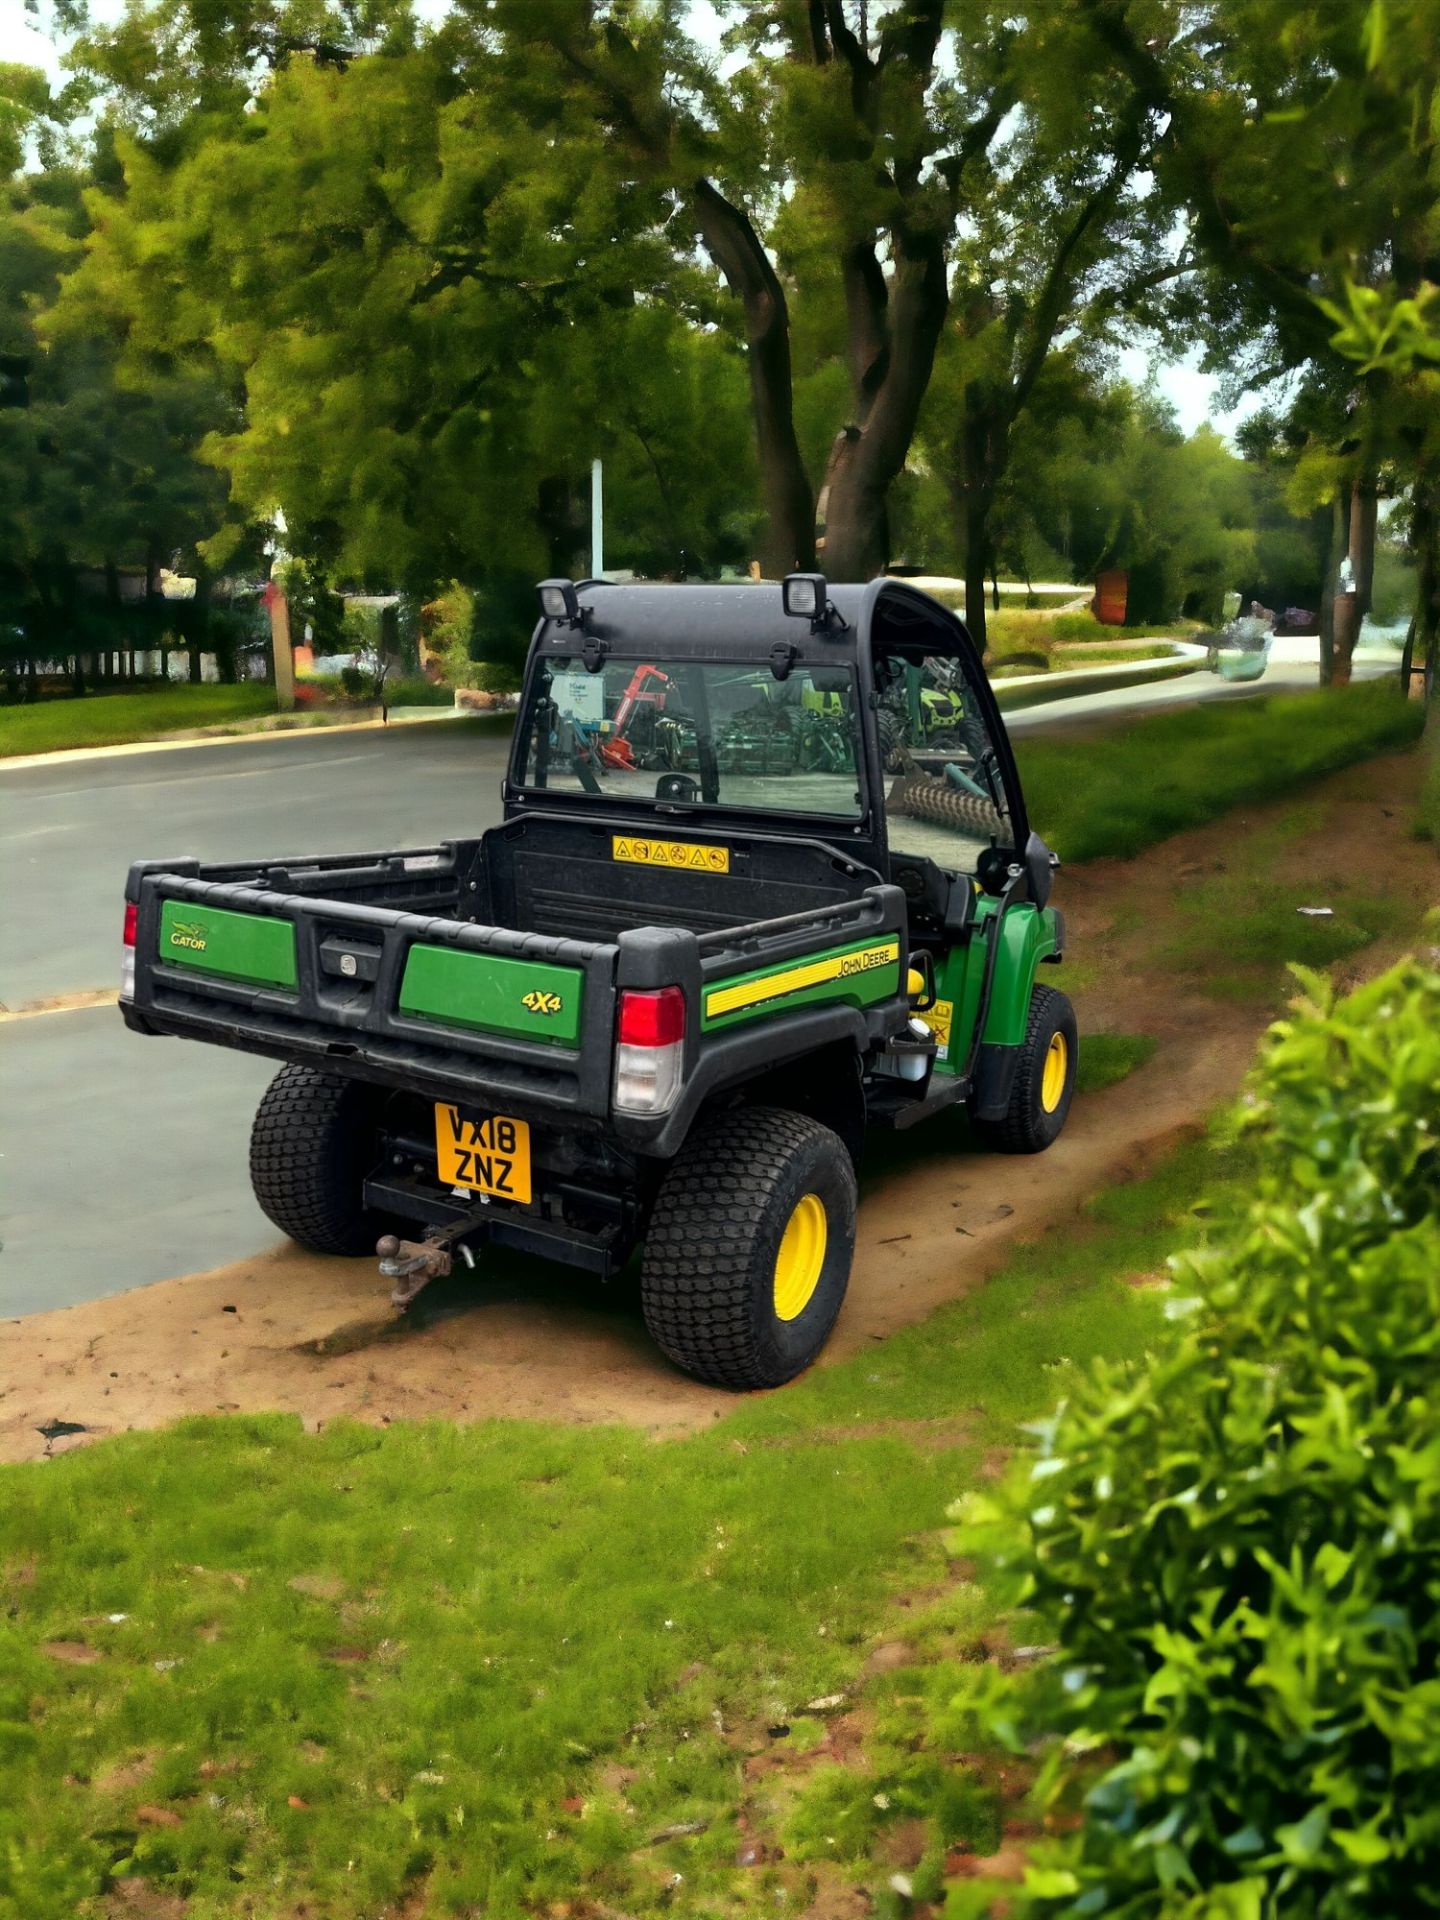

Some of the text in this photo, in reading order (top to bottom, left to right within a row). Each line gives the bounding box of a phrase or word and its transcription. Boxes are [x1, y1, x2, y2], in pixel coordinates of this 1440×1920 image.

[171, 933, 206, 950] GATOR
[838, 950, 890, 976] JOHN DEERE
[454, 1148, 514, 1193] ZNZ
